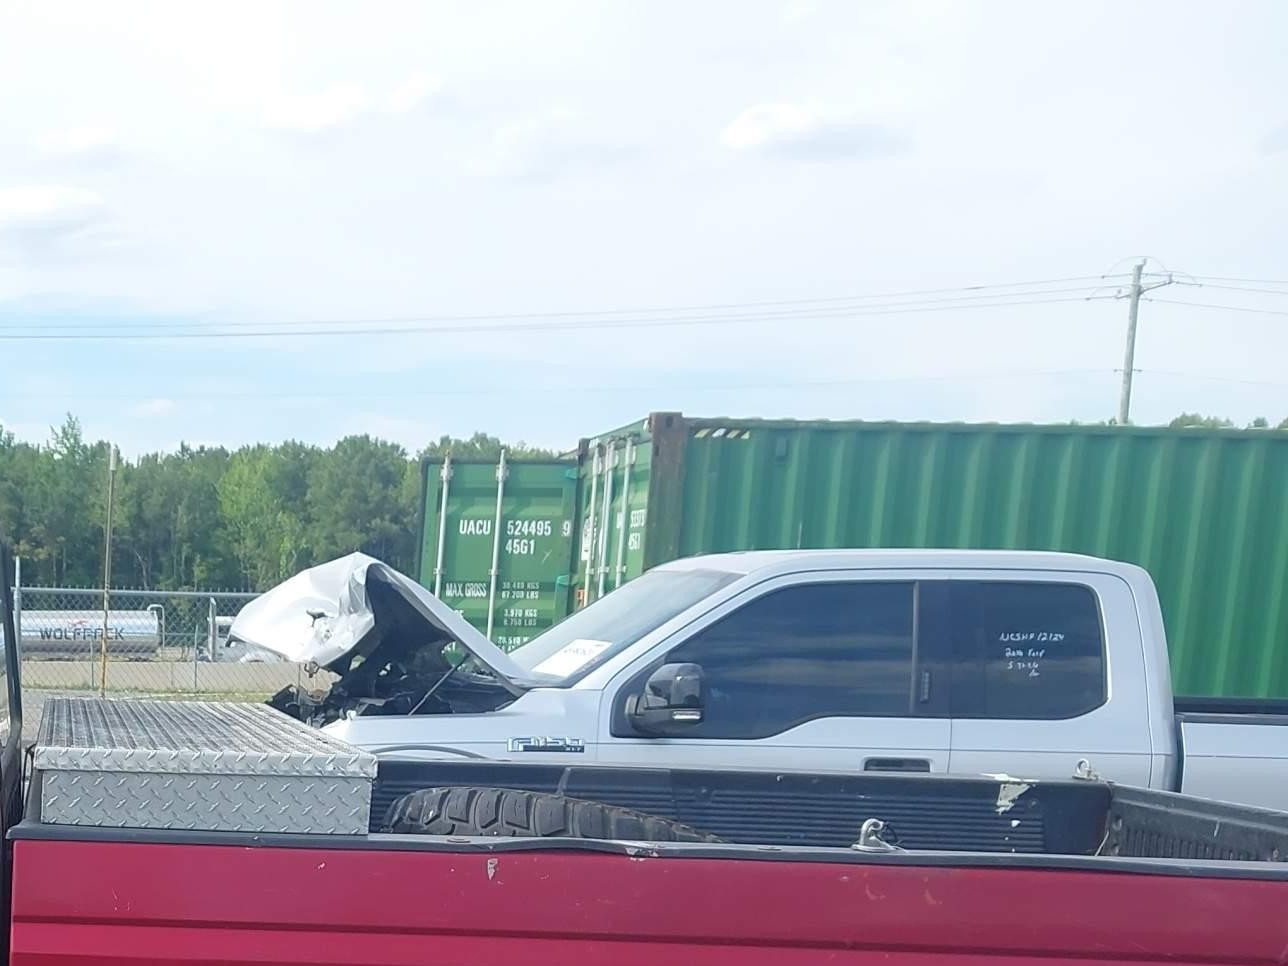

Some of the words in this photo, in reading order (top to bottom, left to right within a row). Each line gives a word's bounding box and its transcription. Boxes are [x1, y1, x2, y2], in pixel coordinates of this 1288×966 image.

[459, 519, 491, 535] UACU
[506, 520, 552, 537] 524495
[561, 522, 571, 537] 9
[505, 539, 536, 555] 45G1
[445, 582, 464, 597] MAX
[464, 582, 488, 597] GROSS
[526, 590, 540, 599] LBS
[524, 608, 538, 617] KGS
[524, 618, 537, 626] LBS
[39, 626, 126, 641] WOLFPACK
